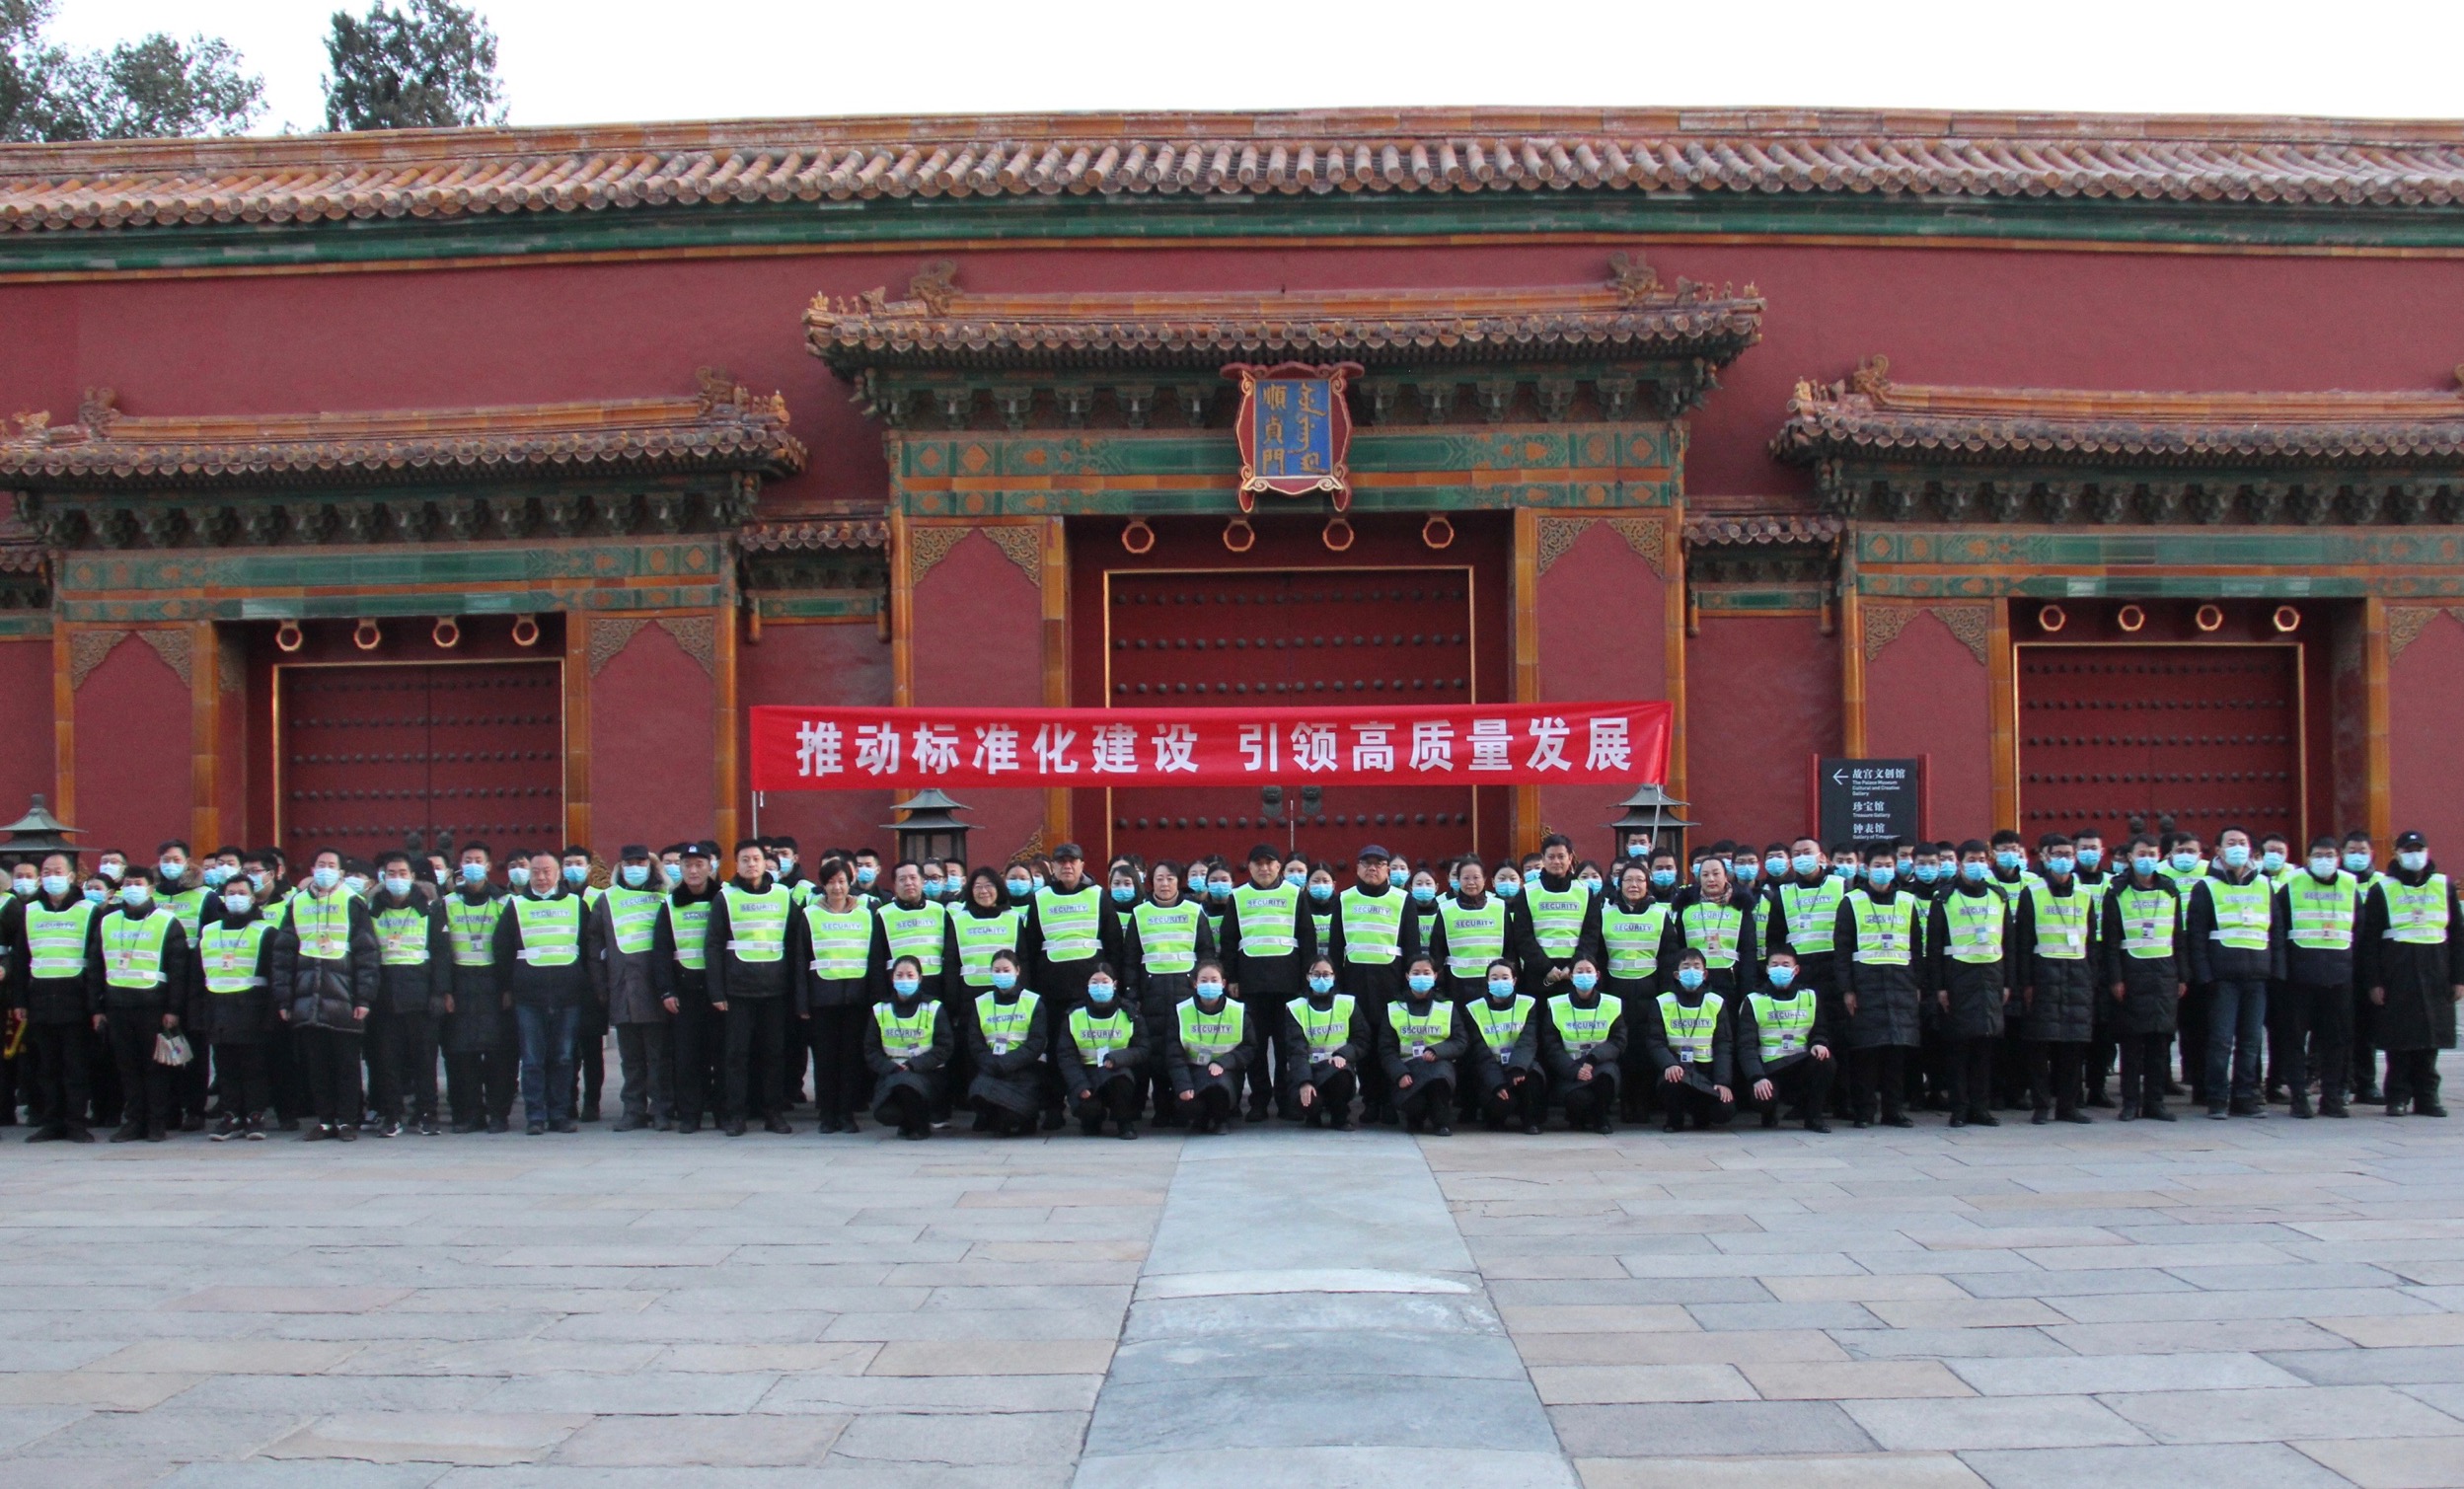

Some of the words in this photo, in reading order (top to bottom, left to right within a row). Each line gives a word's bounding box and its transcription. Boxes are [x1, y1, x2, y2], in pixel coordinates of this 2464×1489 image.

[1262, 383, 1288, 476] 順貞門
[795, 720, 1200, 777] 推动标准化建设
[1237, 716, 1632, 773] 引领高质量发展
[1852, 768, 1905, 780] 故宫文创馆
[1853, 801, 1885, 812] 珍宝馆
[1853, 823, 1885, 834] 钟表馆
[620, 895, 658, 907] SECURITY
[1247, 899, 1287, 908] SECURITY
[1794, 896, 1832, 907] SECURITY
[741, 903, 780, 912] SECURITY
[1048, 904, 1087, 915] SECURITY
[1353, 906, 1391, 916] SECURITY
[1539, 902, 1579, 911] SECURITY
[530, 910, 569, 919] SECURITY
[1691, 912, 1732, 921] SECURITY
[1866, 915, 1904, 924] SECURITY
[896, 918, 935, 929] SECURITY
[1149, 915, 1188, 925] SECURITY
[1456, 920, 1495, 929] SECURITY
[967, 927, 1007, 935] SECURITY
[1613, 924, 1653, 932] SECURITY
[987, 1013, 1025, 1024] SECURITY
[1671, 1018, 1711, 1028] SECURITY
[1191, 1024, 1232, 1033] SECURITY
[1307, 1023, 1345, 1035] SECURITY
[1484, 1021, 1525, 1034] SECURITY
[1566, 1020, 1606, 1030] SECURITY
[885, 1028, 924, 1037] SECURITY
[1081, 1029, 1121, 1038] SECURITY
[1401, 1026, 1441, 1035] SECURITY
